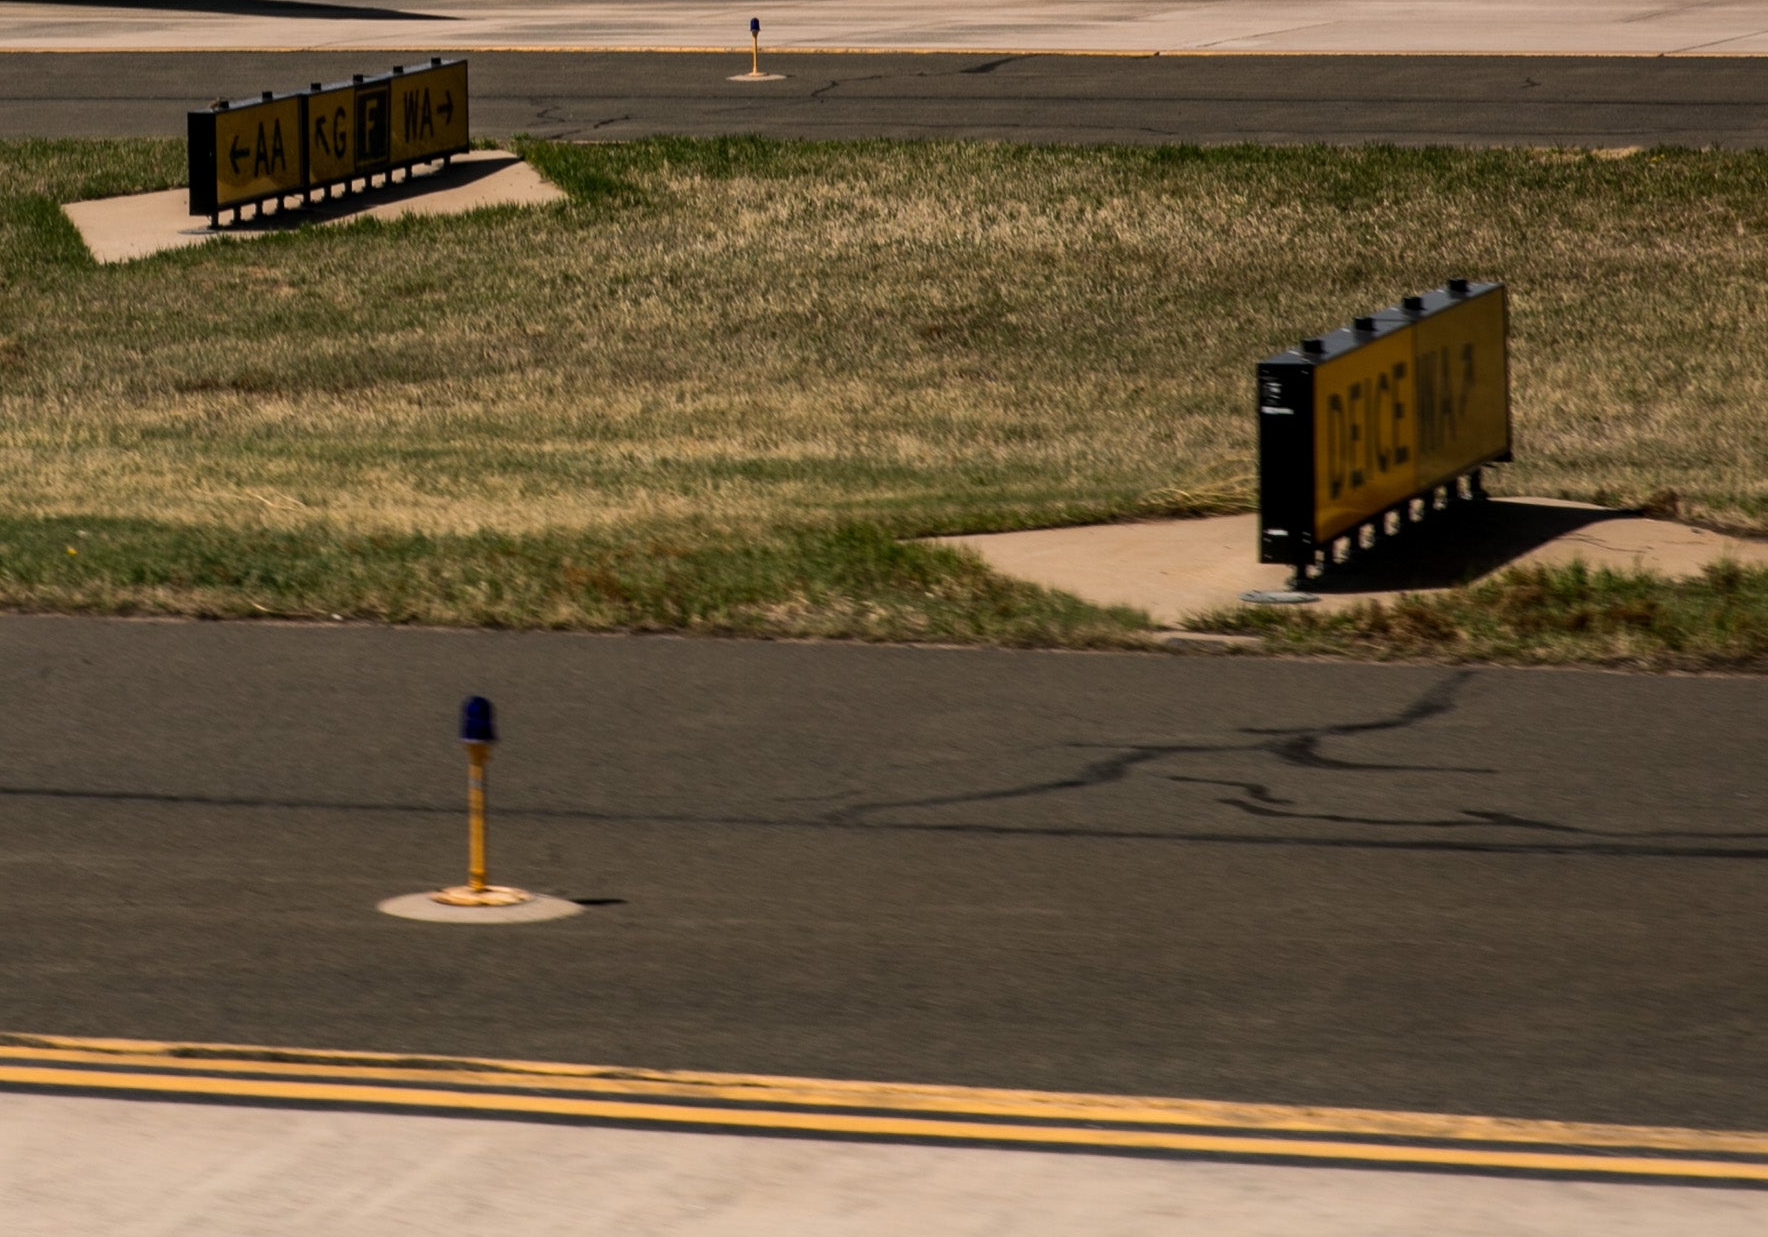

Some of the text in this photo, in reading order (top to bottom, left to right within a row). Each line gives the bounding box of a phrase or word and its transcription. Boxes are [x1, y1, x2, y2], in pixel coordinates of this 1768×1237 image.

[254, 87, 433, 177] AA G F WA
[1327, 361, 1410, 500] DEICE
